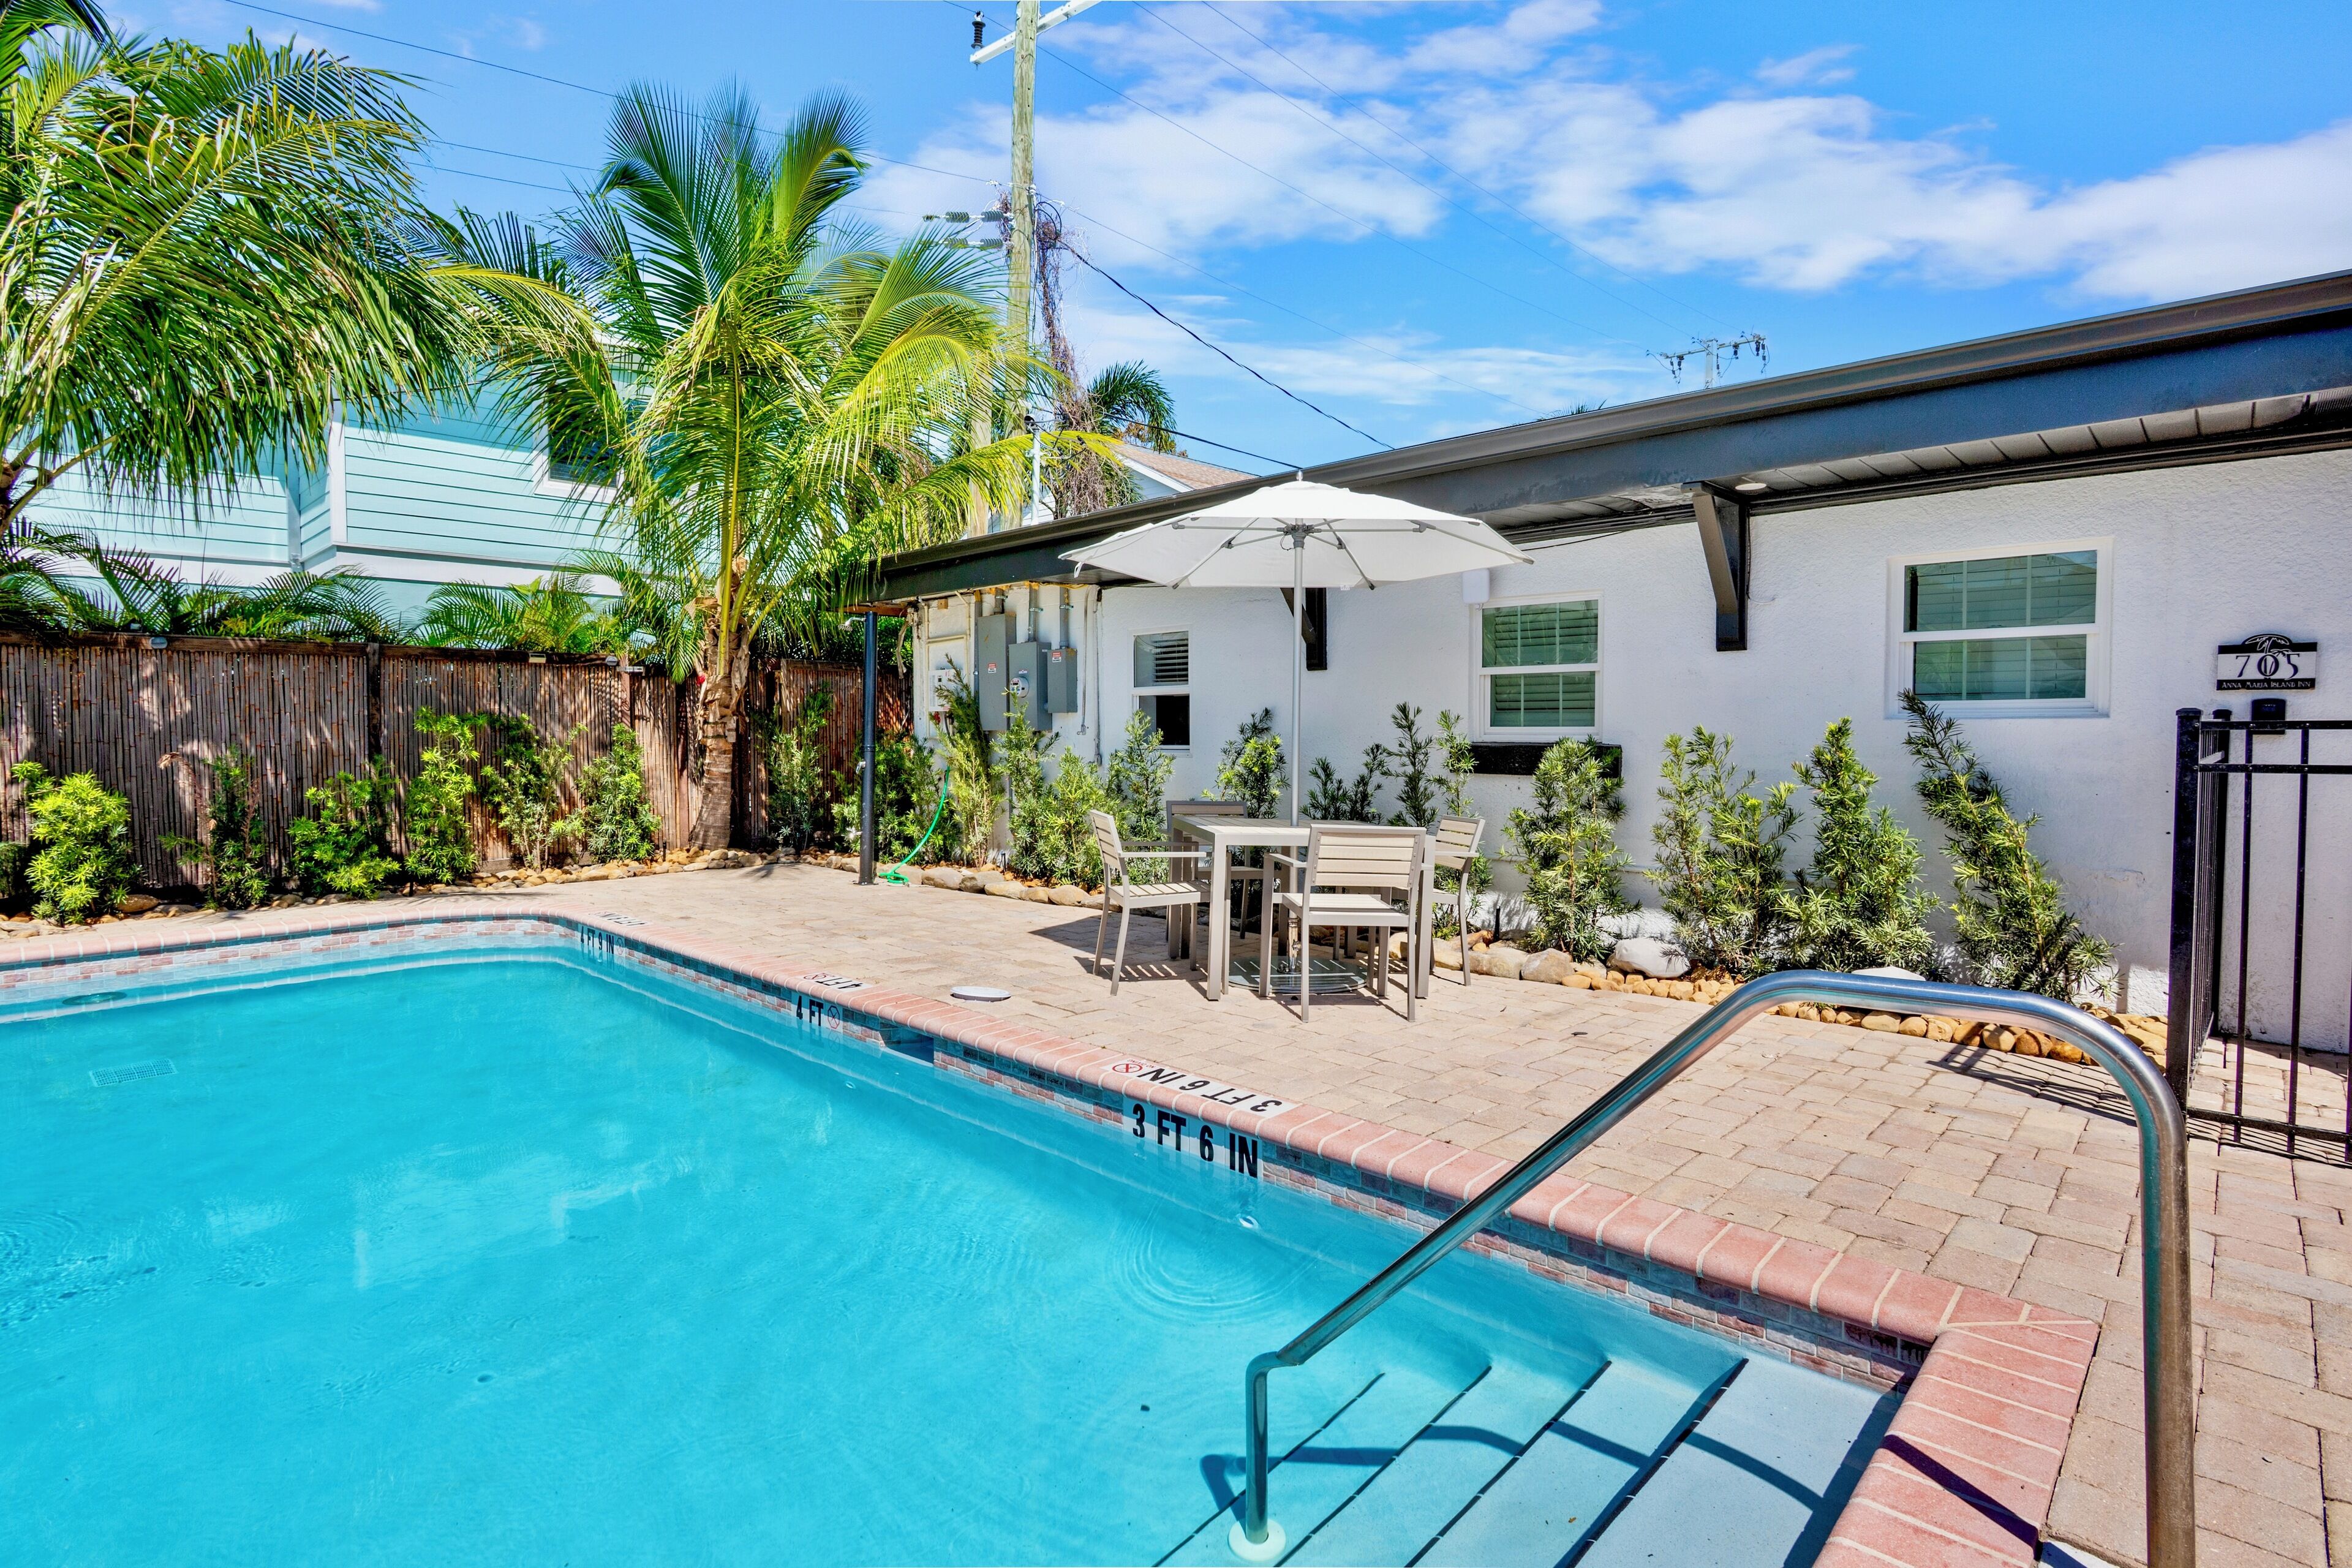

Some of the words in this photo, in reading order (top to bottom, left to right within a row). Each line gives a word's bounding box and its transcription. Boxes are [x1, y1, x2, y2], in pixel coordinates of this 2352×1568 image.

[2236, 653, 2300, 680] 705
[580, 926, 584, 944] 4
[587, 927, 595, 948] FT
[598, 932, 603, 950] 9
[606, 933, 614, 954] IN
[796, 995, 803, 1020] 4
[809, 998, 824, 1027] FT
[1137, 1068, 1186, 1084] IN
[1179, 1080, 1210, 1090] 6
[1200, 1088, 1256, 1105] FT
[1250, 1100, 1282, 1112] 3
[1133, 1103, 1145, 1138] 3
[1157, 1109, 1186, 1152] FT
[1199, 1125, 1214, 1162] 6
[1229, 1132, 1257, 1179] IN
